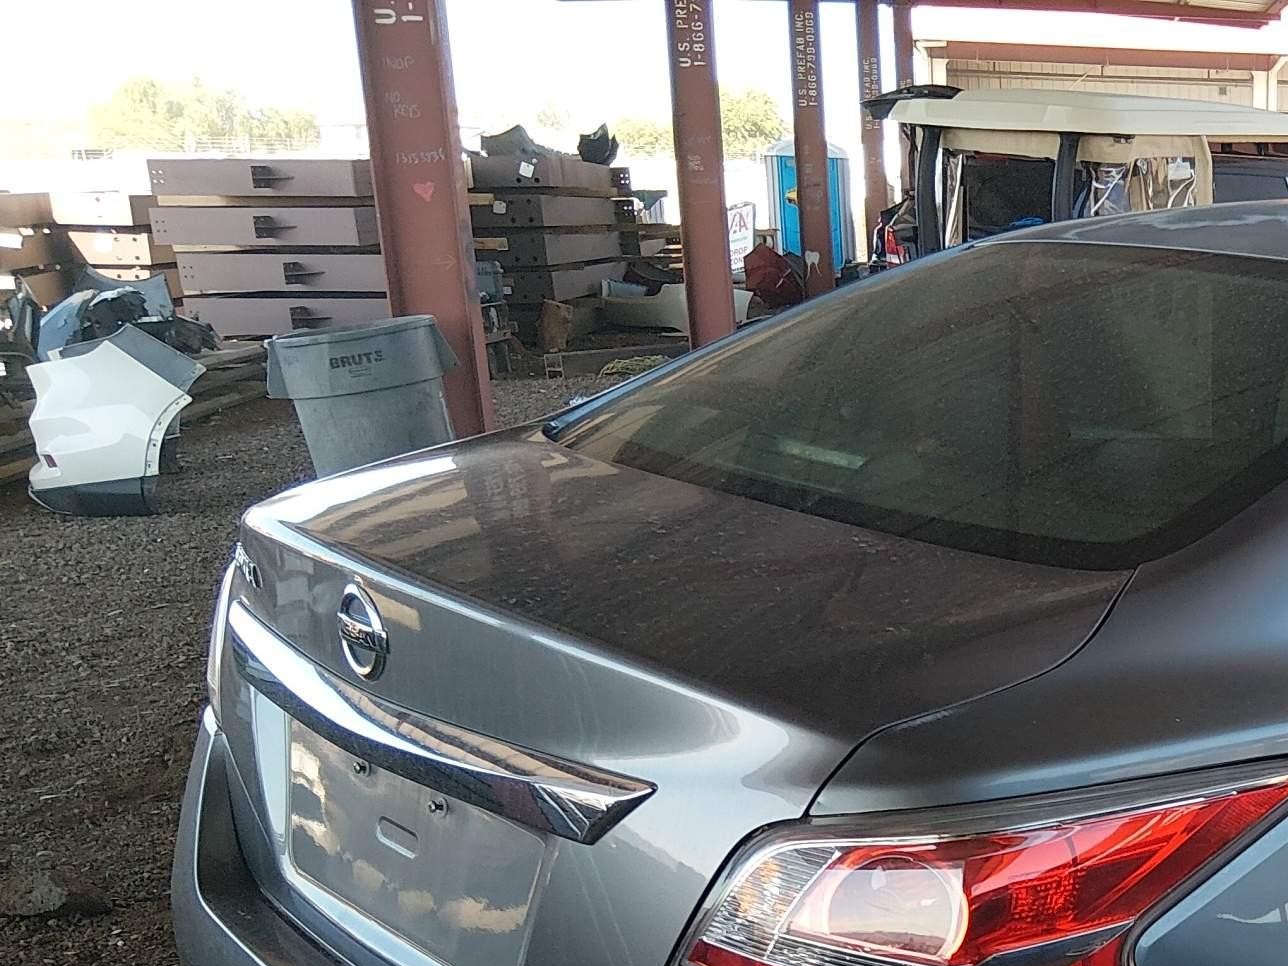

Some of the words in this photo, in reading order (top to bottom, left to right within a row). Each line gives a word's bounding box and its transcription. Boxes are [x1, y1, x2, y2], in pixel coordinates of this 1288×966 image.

[795, 10, 804, 32] INC.
[678, 37, 691, 67] U.S.
[796, 37, 806, 80] PREFAB
[798, 86, 808, 107] U.S.
